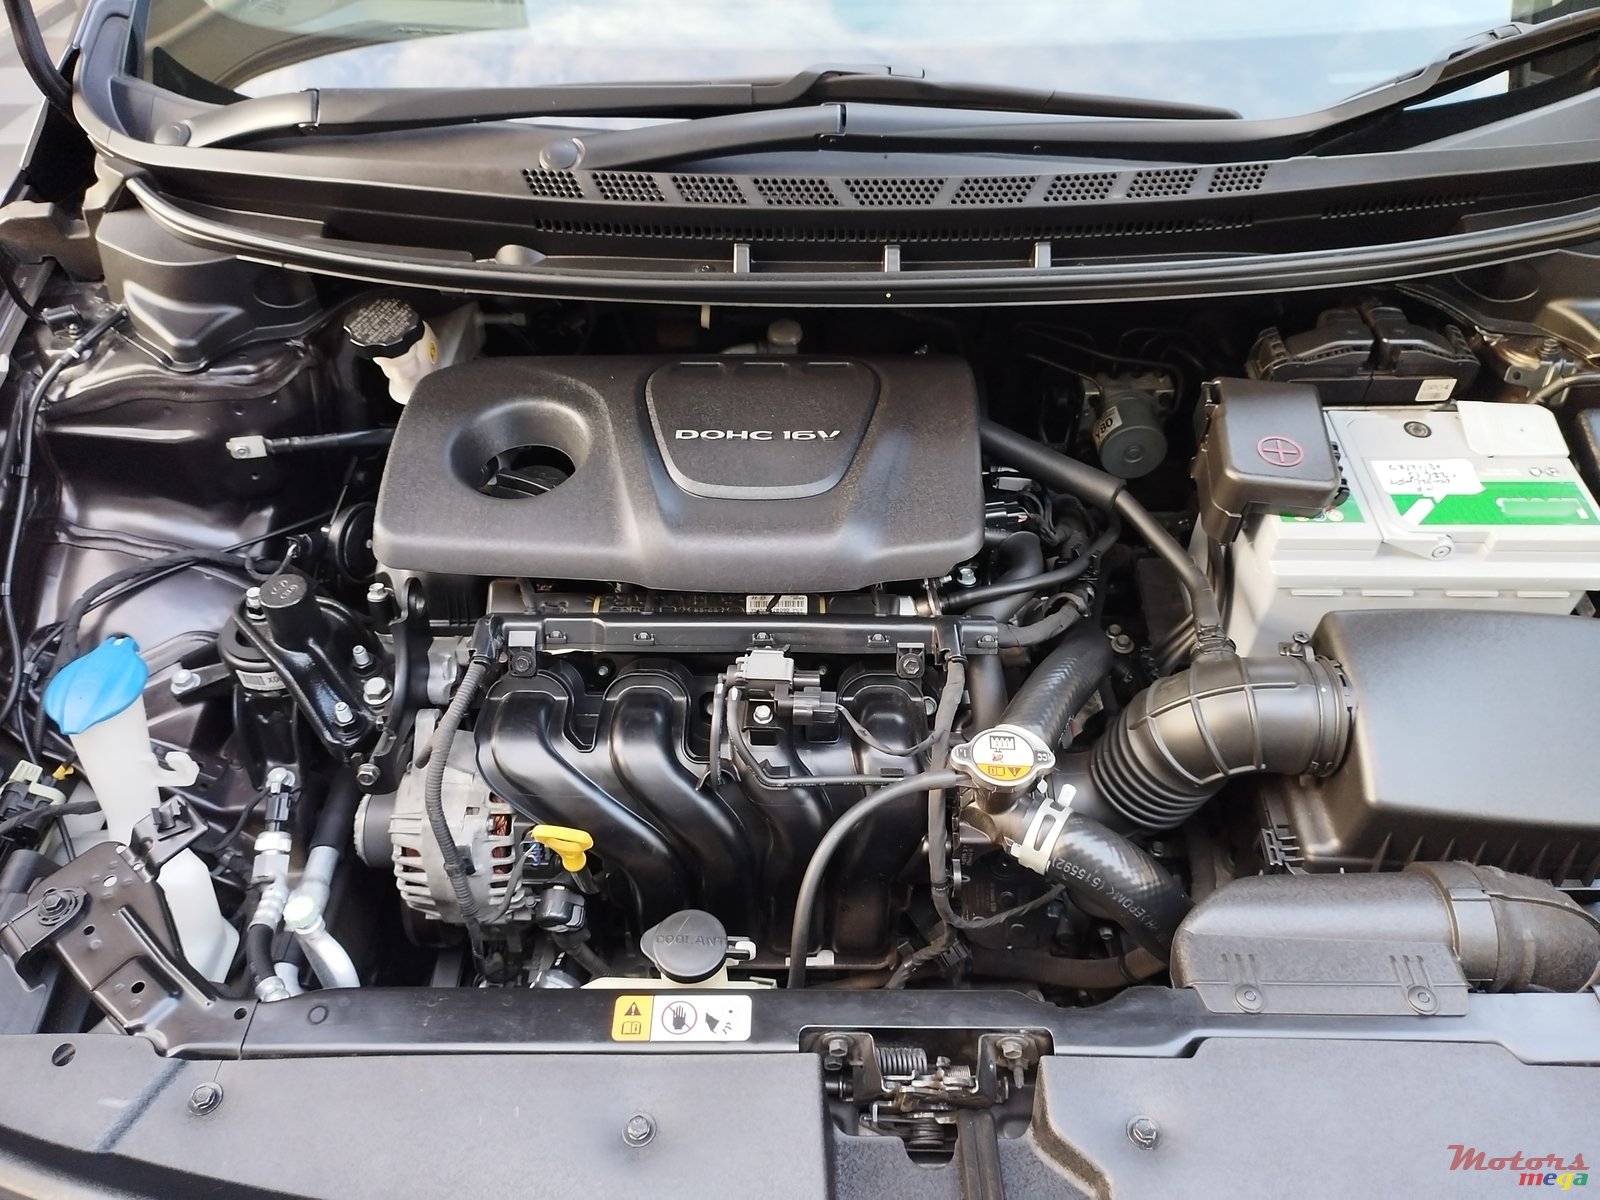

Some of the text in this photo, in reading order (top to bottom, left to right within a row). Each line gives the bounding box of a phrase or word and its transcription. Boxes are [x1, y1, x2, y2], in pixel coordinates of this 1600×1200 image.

[675, 429, 841, 442] DOHC 16V
[656, 934, 726, 946] COOLANT
